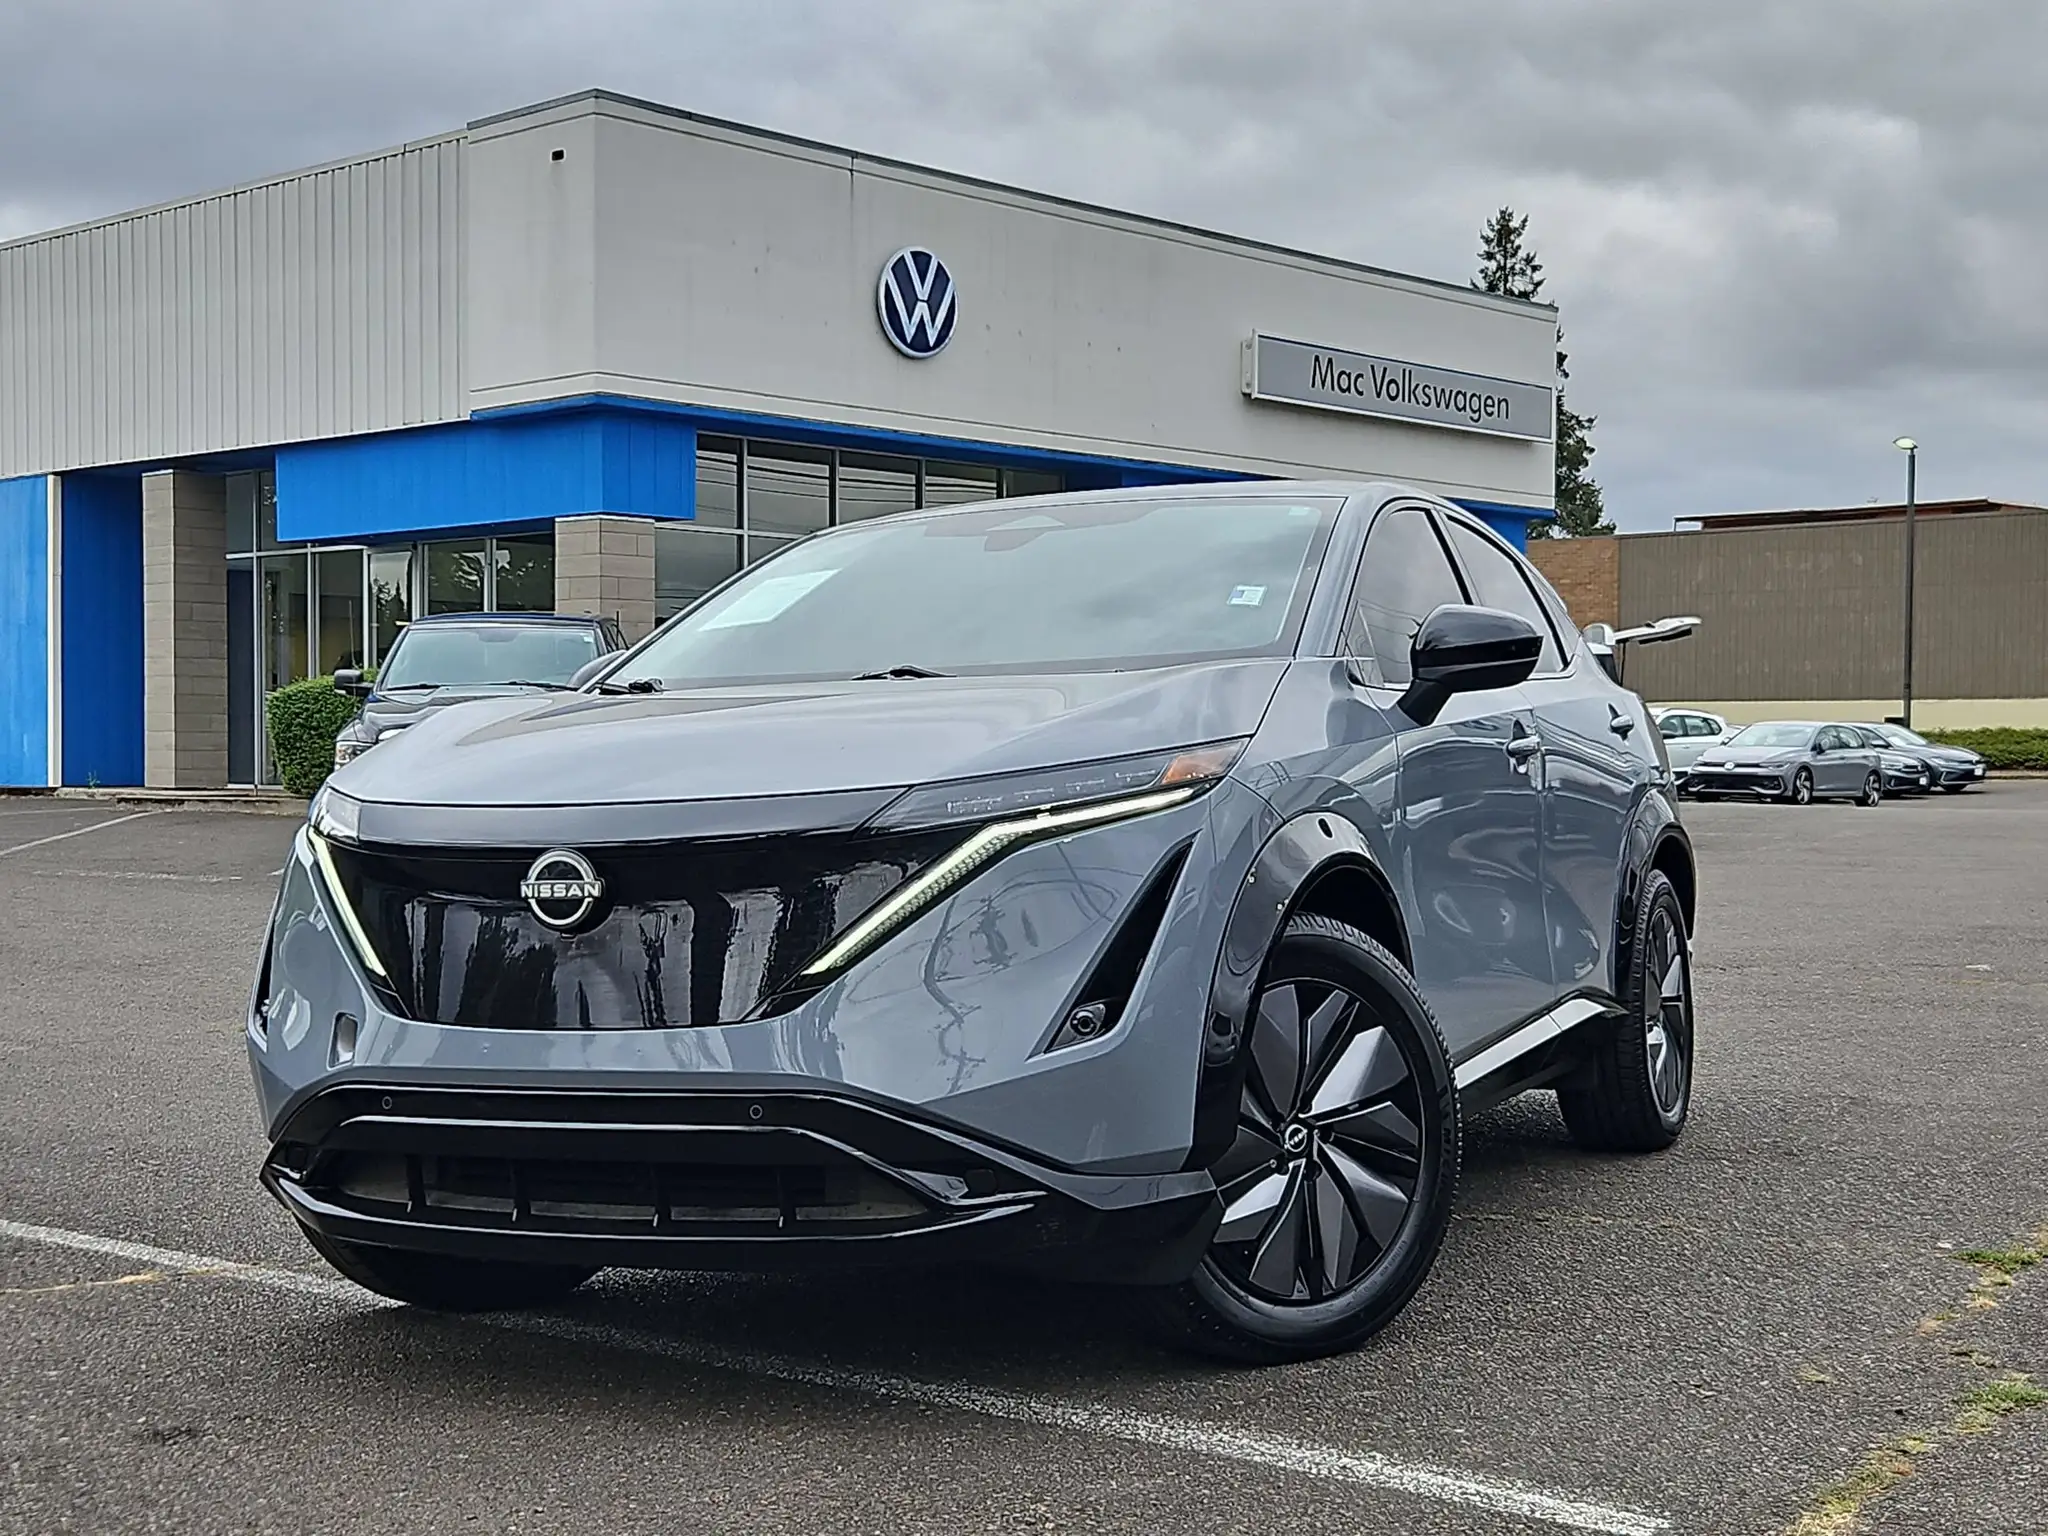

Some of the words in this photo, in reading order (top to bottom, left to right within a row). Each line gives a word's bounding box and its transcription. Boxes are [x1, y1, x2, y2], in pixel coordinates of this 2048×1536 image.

[1311, 354, 1364, 396] Mac
[1370, 364, 1509, 423] Volkswagen
[520, 883, 600, 898] NISSAN
